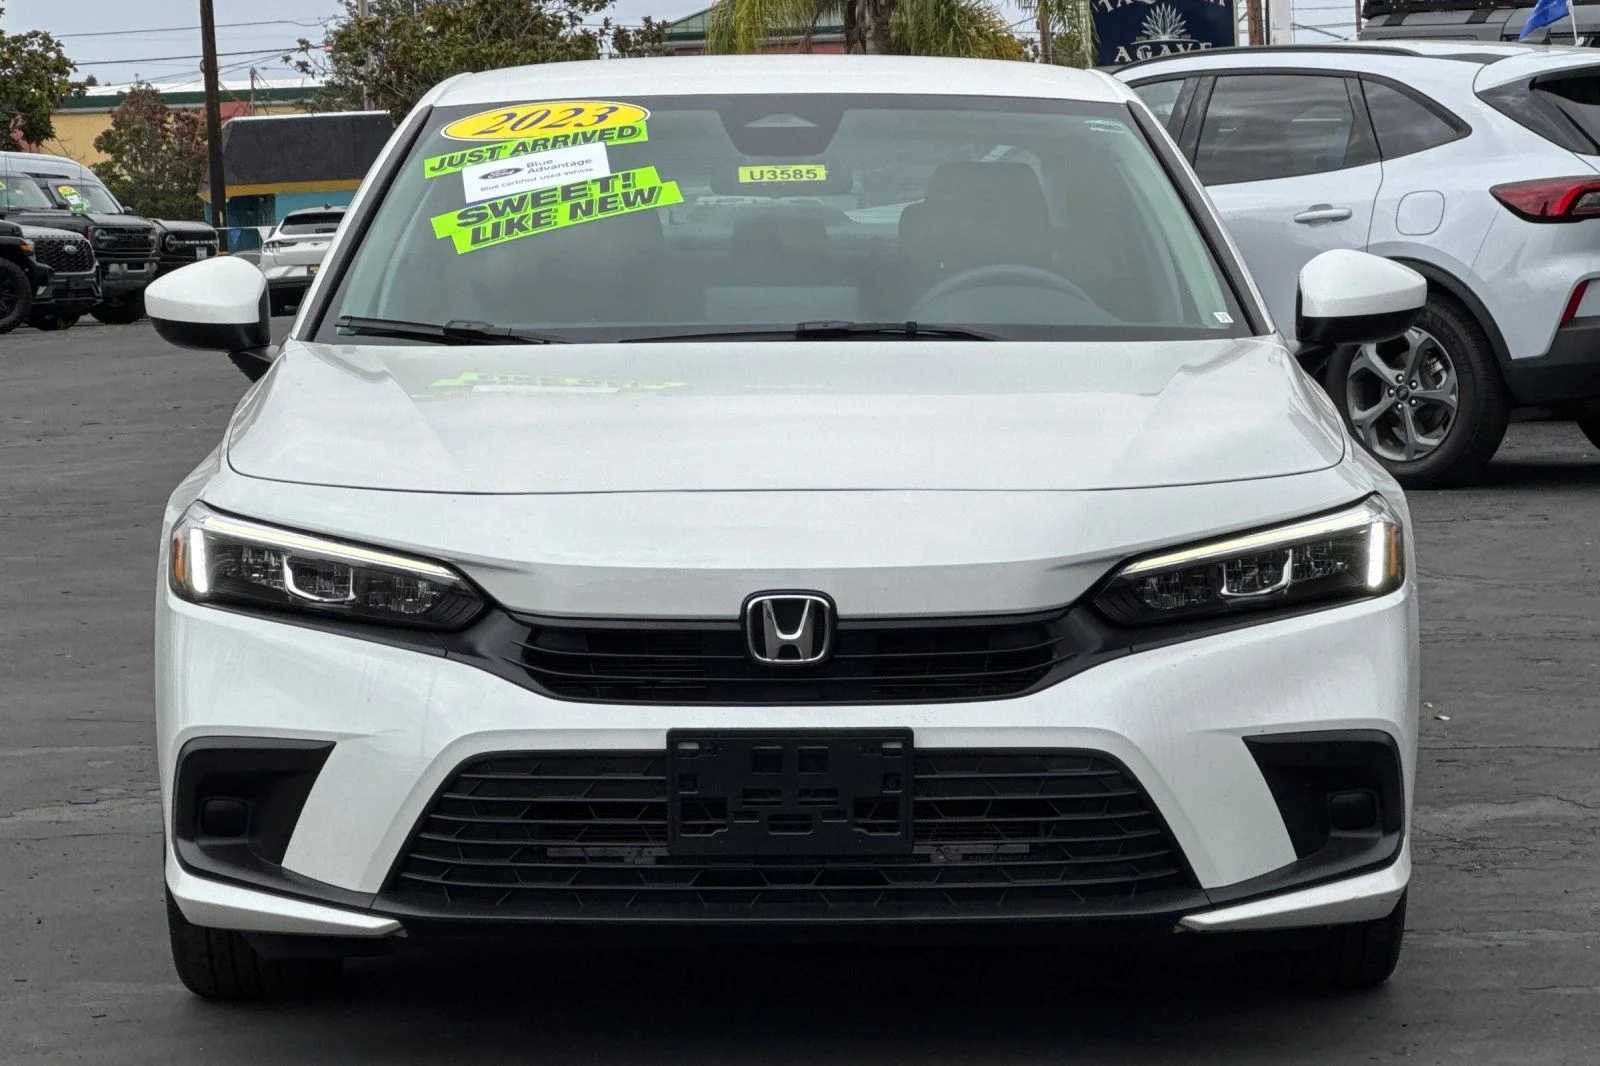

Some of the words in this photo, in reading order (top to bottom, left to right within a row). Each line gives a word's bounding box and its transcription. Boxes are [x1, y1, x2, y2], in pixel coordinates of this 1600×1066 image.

[472, 106, 620, 136] 2023
[430, 144, 507, 172] JUST
[508, 125, 642, 156] ARRIVED
[526, 159, 553, 168] Blue
[527, 158, 593, 174] Advantage
[749, 169, 818, 181] U3585
[501, 177, 537, 188] Certified
[539, 172, 561, 181] Used
[563, 167, 594, 176] Vehicle
[456, 172, 636, 228] SWEET!
[470, 209, 559, 247] LIKE
[568, 186, 663, 222] NEW
